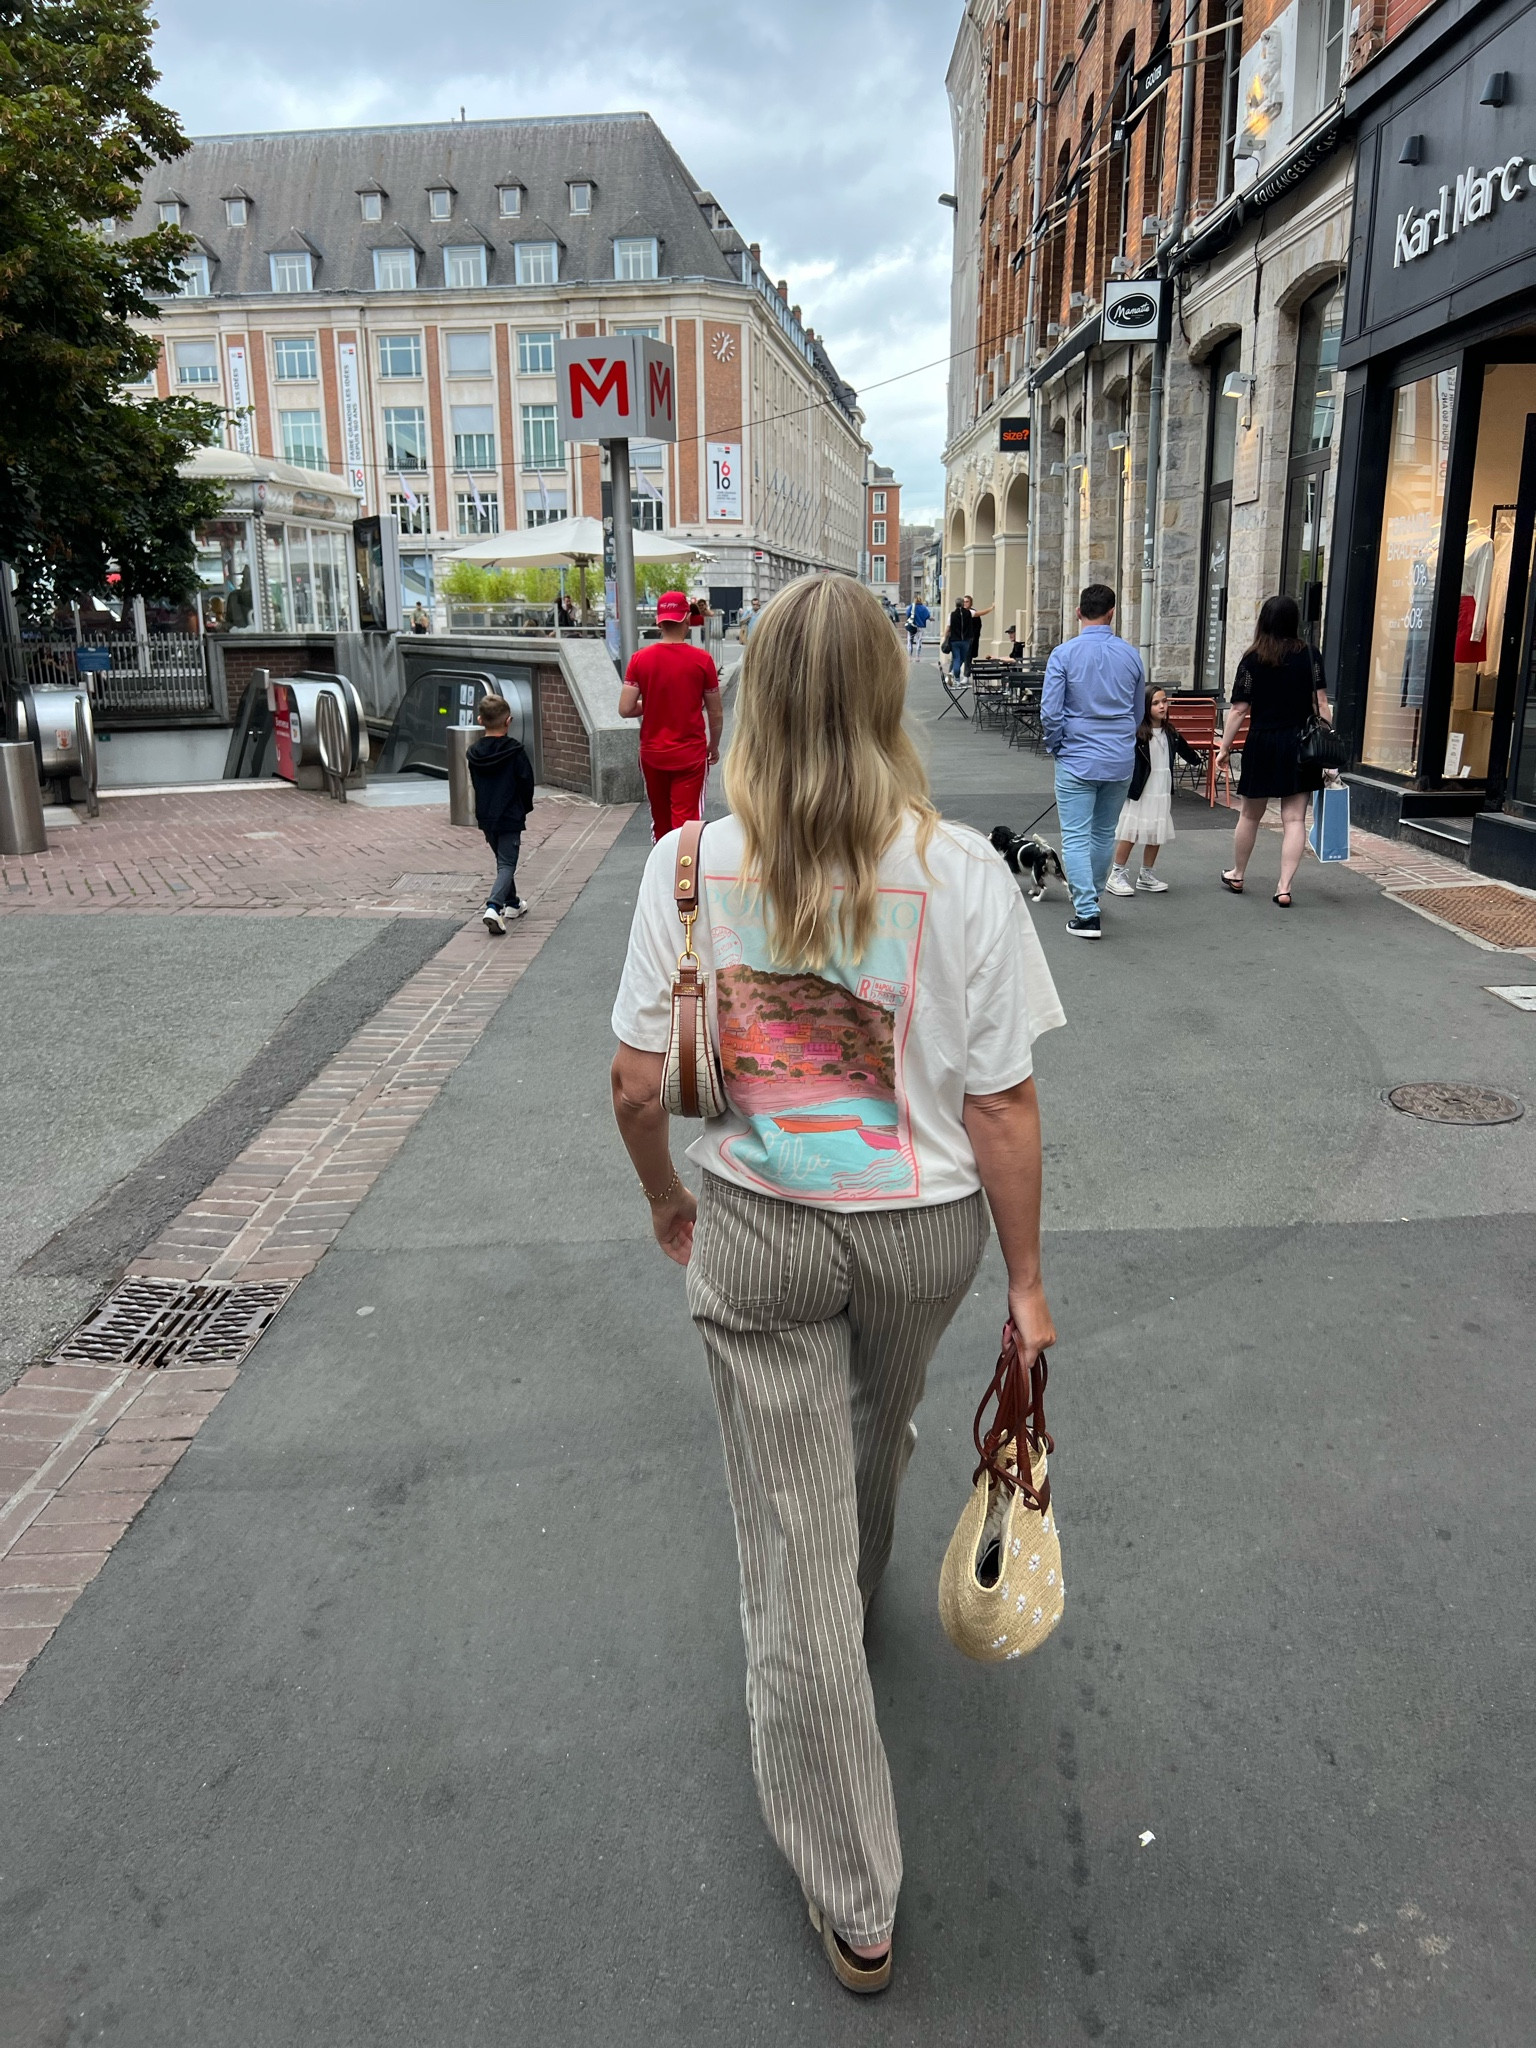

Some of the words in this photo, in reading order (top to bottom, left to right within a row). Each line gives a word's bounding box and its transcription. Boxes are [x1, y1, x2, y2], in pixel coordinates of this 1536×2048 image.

[1394, 185, 1449, 268] Karl
[1452, 156, 1524, 234] Marc
[569, 358, 629, 418] M
[649, 360, 672, 421] M
[1002, 429, 1030, 441] size?
[1401, 608, 1423, 629] -60%
[859, 978, 871, 998] R
